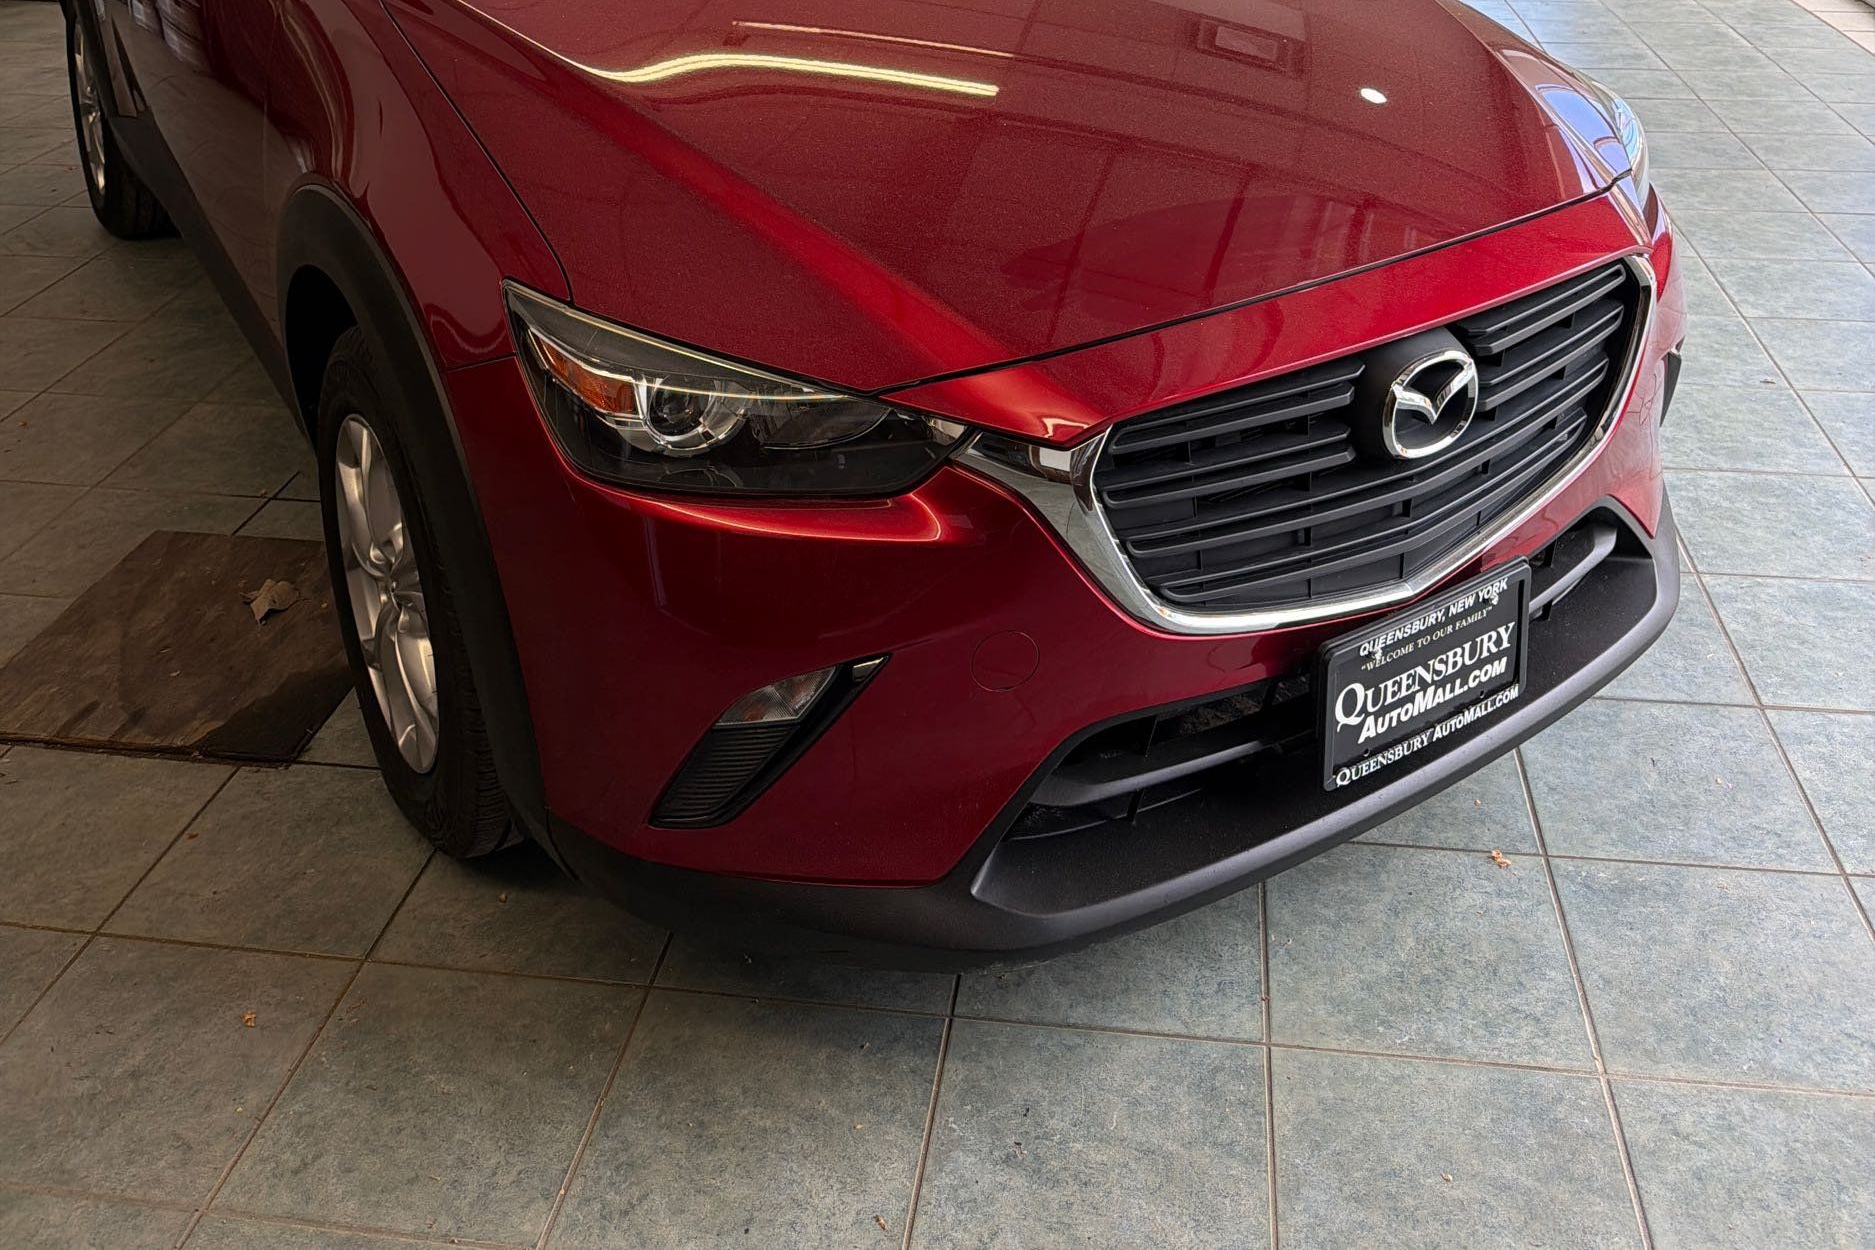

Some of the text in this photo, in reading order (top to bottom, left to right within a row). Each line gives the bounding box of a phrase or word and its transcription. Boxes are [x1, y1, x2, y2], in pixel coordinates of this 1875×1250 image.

[1359, 577, 1509, 657] QUEENSBURY, NEW YORK
[1416, 636, 1430, 649] TO
[1432, 625, 1453, 642] OUR
[1334, 621, 1516, 733] QUEENSBURY
[1336, 730, 1434, 788] QUEENSBURY
